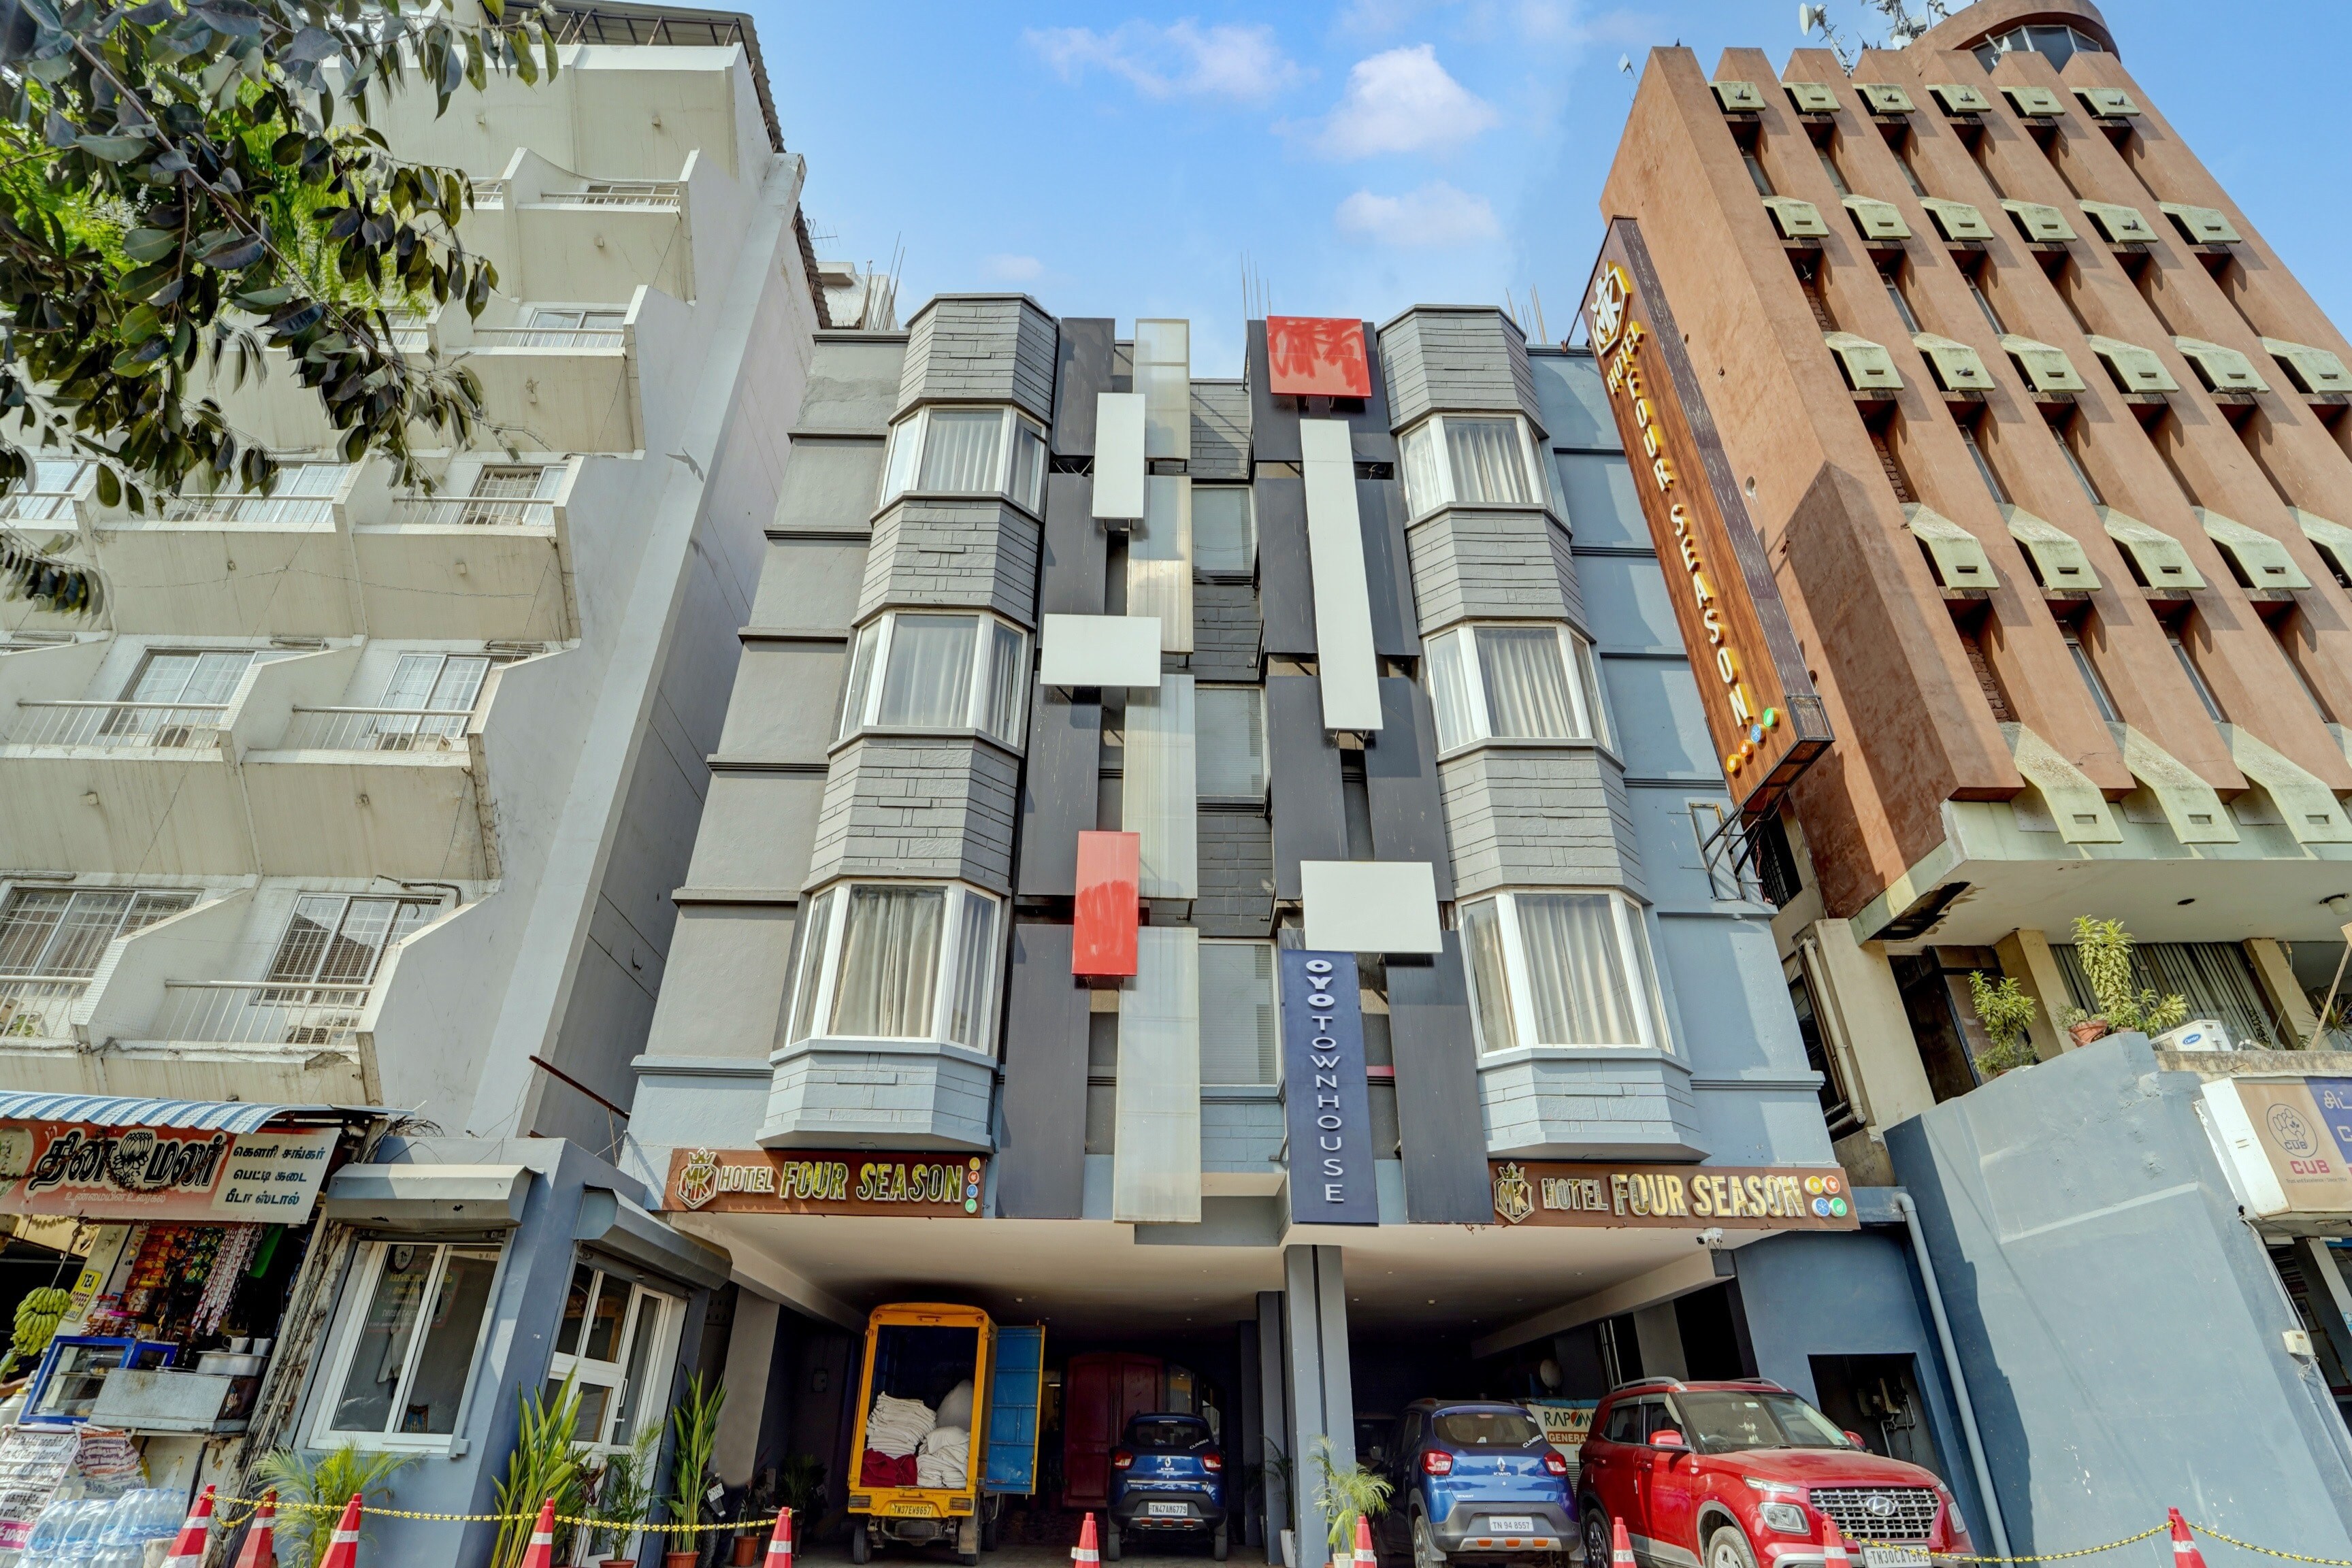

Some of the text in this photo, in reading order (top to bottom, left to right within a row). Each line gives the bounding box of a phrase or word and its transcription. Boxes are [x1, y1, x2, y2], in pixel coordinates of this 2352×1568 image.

[1607, 321, 1646, 395] HOTEL
[1626, 368, 1675, 492] FOUR
[1670, 503, 1754, 728] SEASON
[1306, 959, 1335, 1009] OYO
[1309, 1015, 1345, 1203] TOWNHOUSE
[282, 1147, 325, 1160] சங்கர்
[2284, 1141, 2308, 1150] CUB
[2290, 1160, 2330, 1175] CUB
[233, 1169, 306, 1183] பெட்டி கடை
[718, 1165, 774, 1194] HOTEL
[779, 1161, 849, 1200] FOUR
[856, 1162, 963, 1203] SEASON
[225, 1188, 300, 1205] பீடா ஸ்டால்
[1541, 1177, 1609, 1211] HOTEL
[1609, 1173, 1688, 1217] FOUR
[1690, 1174, 1807, 1218] SEASON
[81, 1273, 95, 1289] TEA
[70, 1290, 90, 1307] COFFEE
[1189, 1439, 1209, 1450] CLIMBER
[1522, 1434, 1544, 1448] CLIMBER
[1548, 1433, 1588, 1443] GENERA
[1152, 1505, 1187, 1514] TN47AM6779
[1514, 1522, 1530, 1530] 8557
